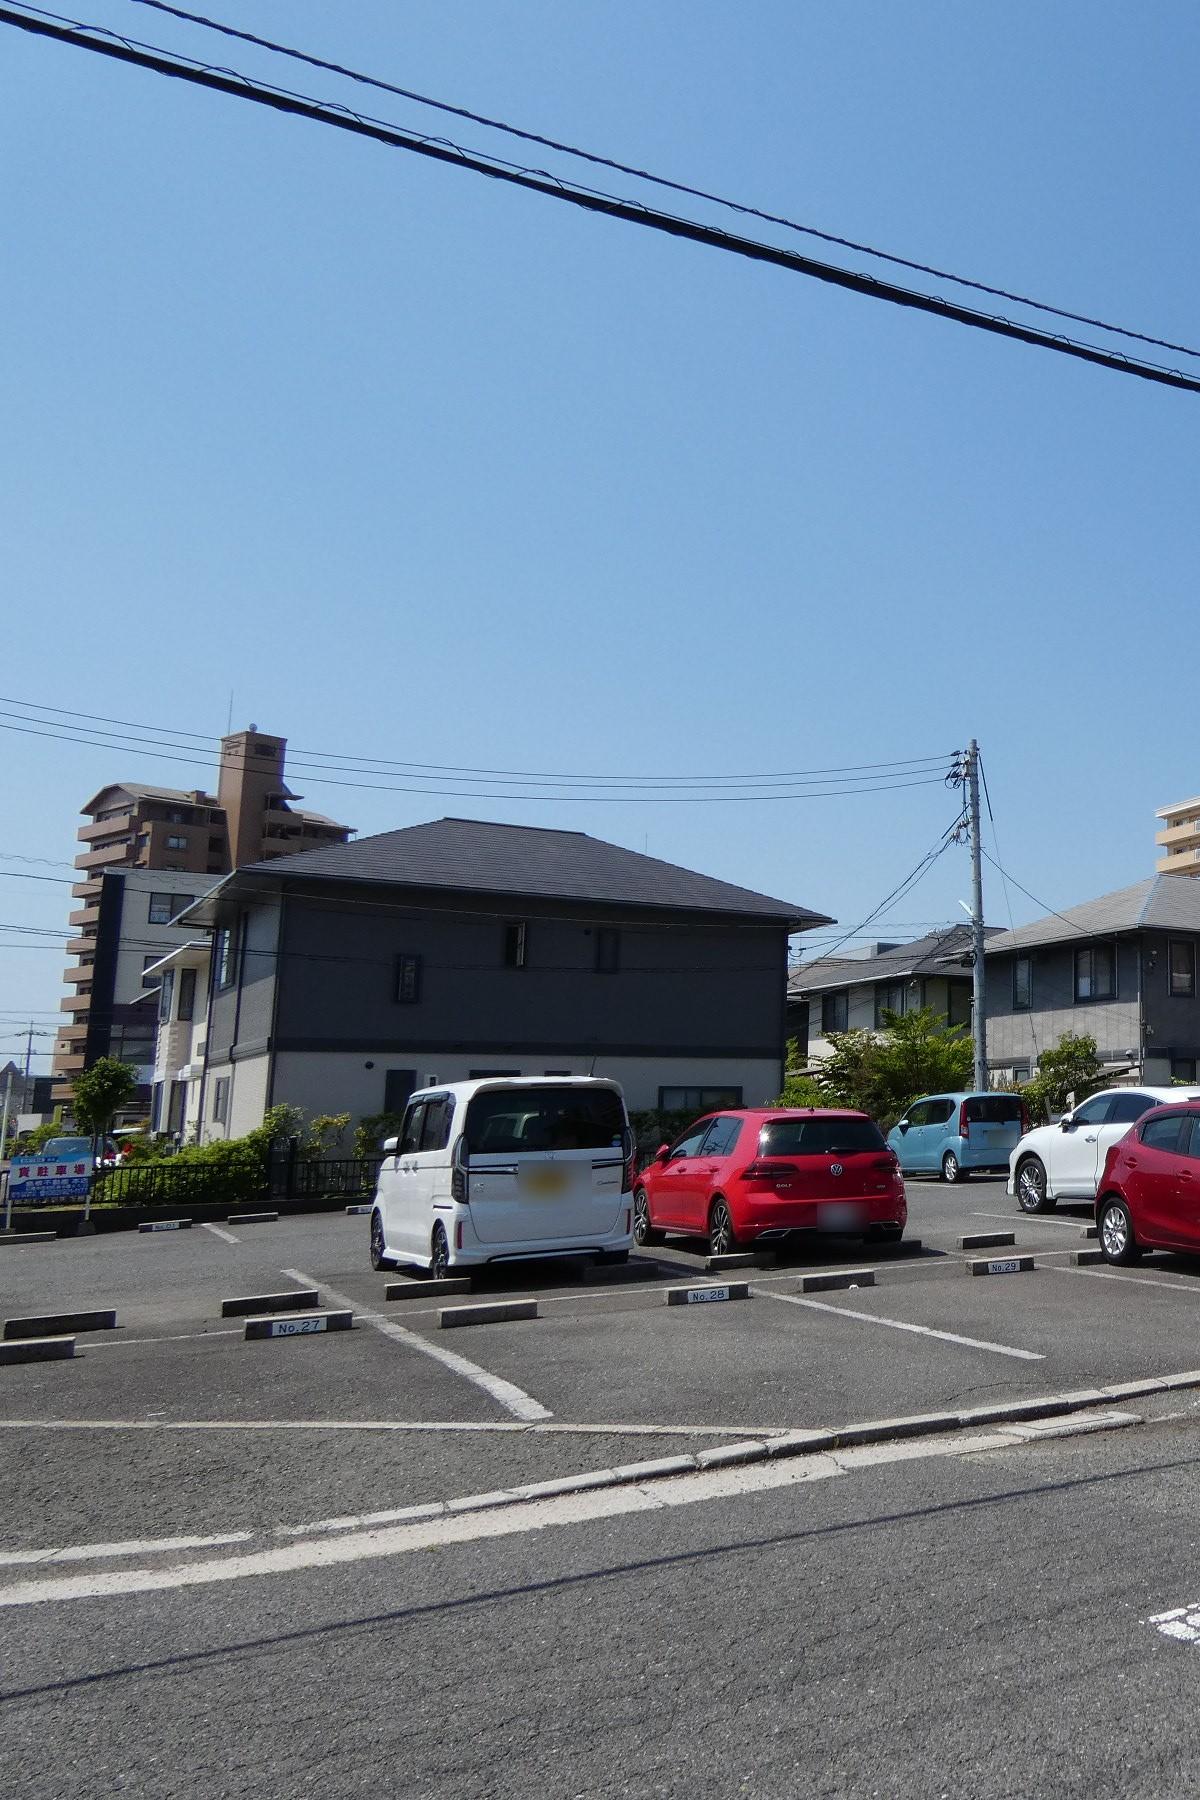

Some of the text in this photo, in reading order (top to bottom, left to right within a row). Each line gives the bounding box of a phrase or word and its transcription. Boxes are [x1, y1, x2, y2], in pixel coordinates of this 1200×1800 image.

[992, 1262, 1016, 1272] No.29
[692, 1289, 725, 1301] No.28
[278, 1320, 320, 1334] No.27
